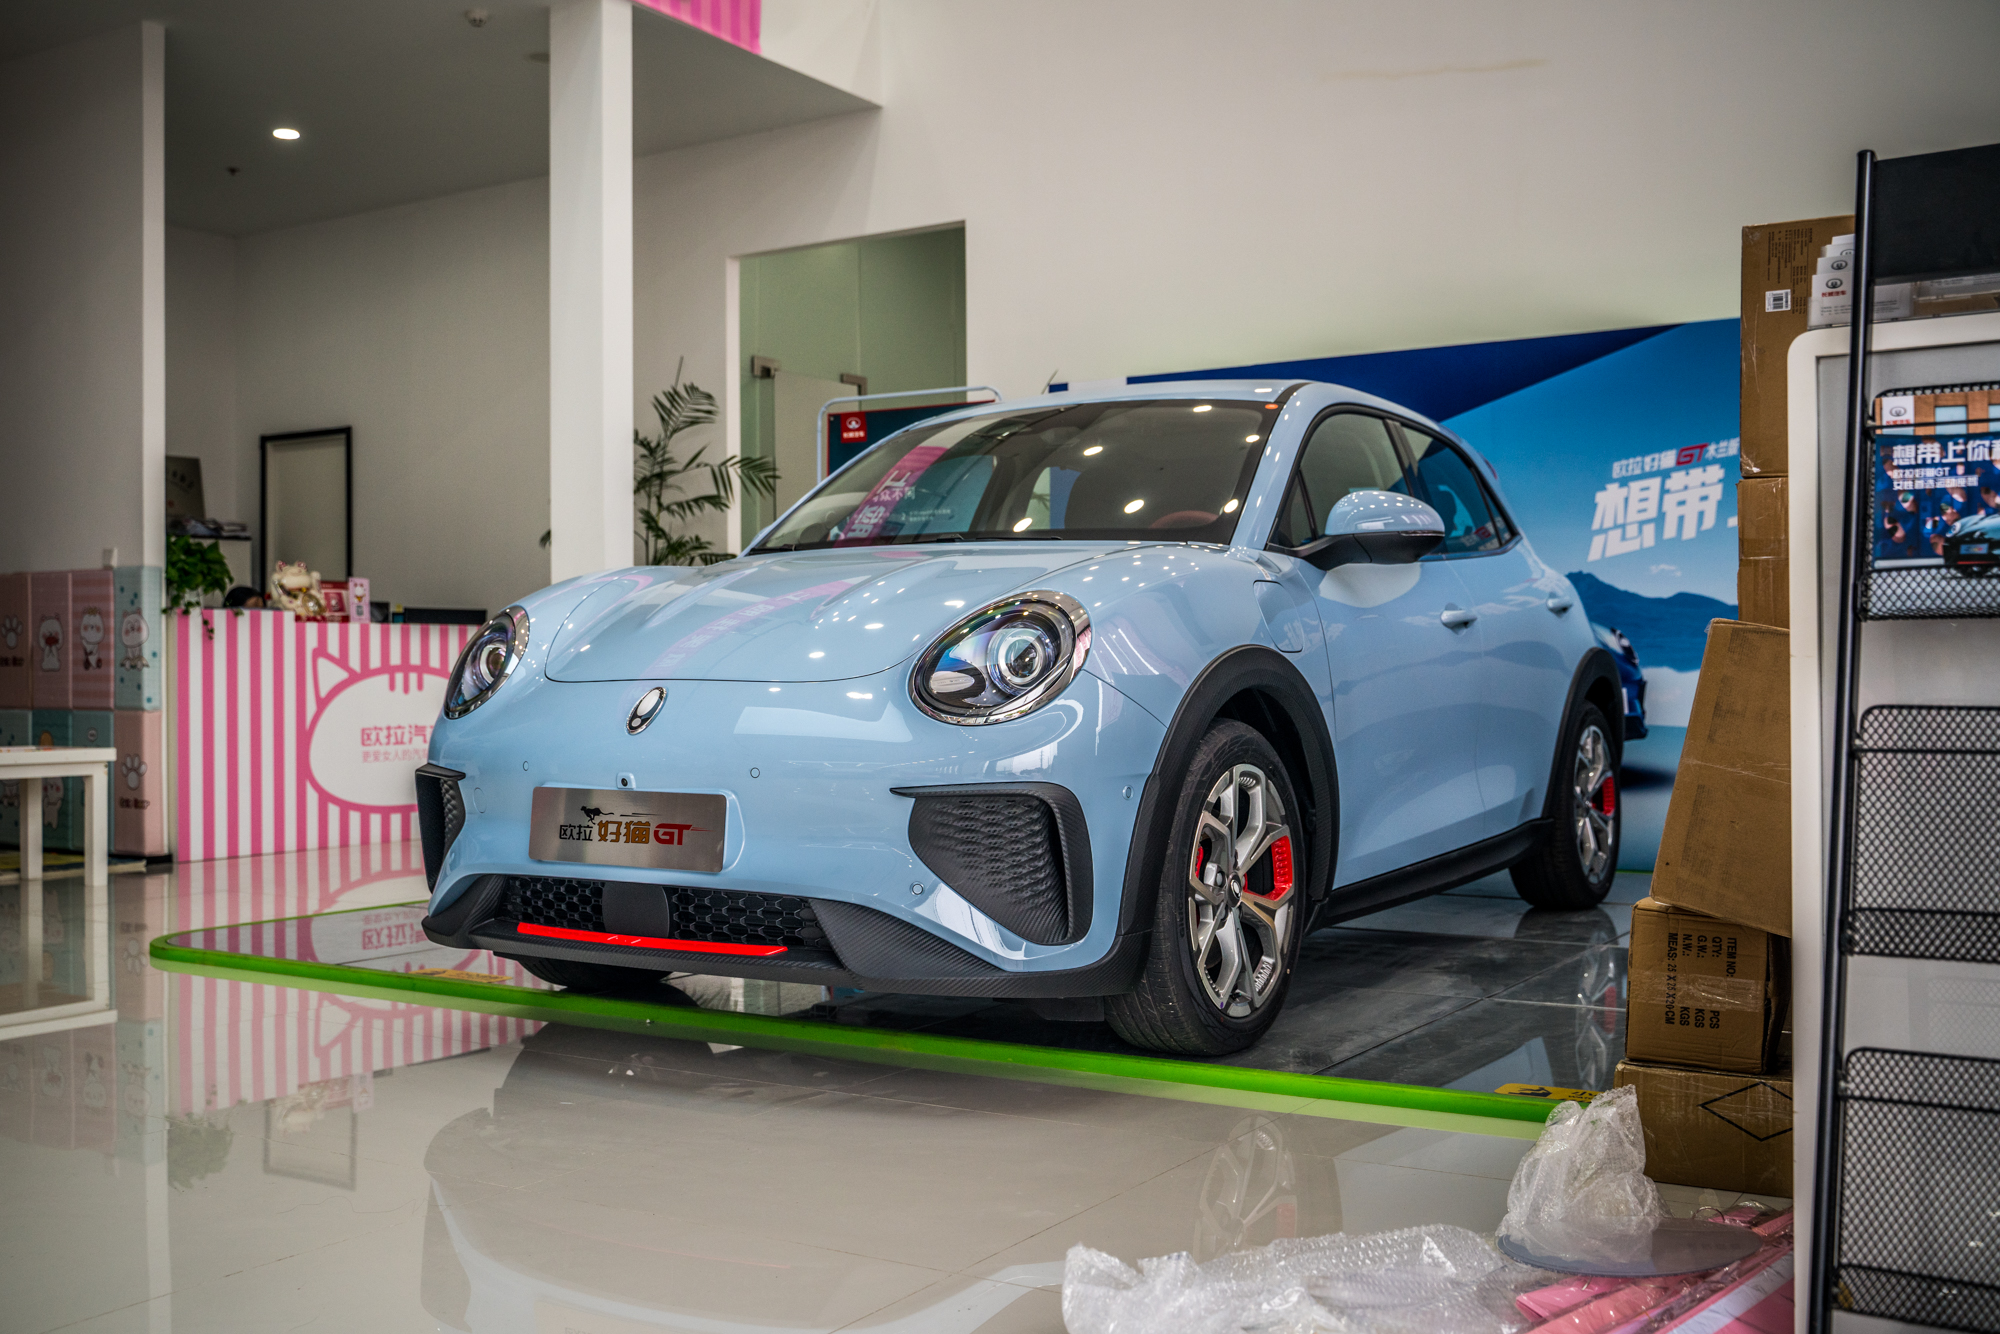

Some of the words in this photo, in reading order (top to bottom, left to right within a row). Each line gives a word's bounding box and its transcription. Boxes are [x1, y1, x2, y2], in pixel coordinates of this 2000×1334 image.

[1587, 464, 1738, 562] 想带
[361, 724, 434, 747] 欧拉汽
[1667, 932, 1678, 961] MEAS:
[1682, 933, 1693, 957] N.W.:
[1697, 935, 1708, 959] G.W.:
[1712, 936, 1723, 958] QTY:
[1727, 938, 1737, 959] ITEM
[1726, 960, 1736, 978] NO:
[1679, 1006, 1690, 1027] KGS
[1694, 1008, 1705, 1028] KGS
[1709, 1010, 1720, 1029] PCS
